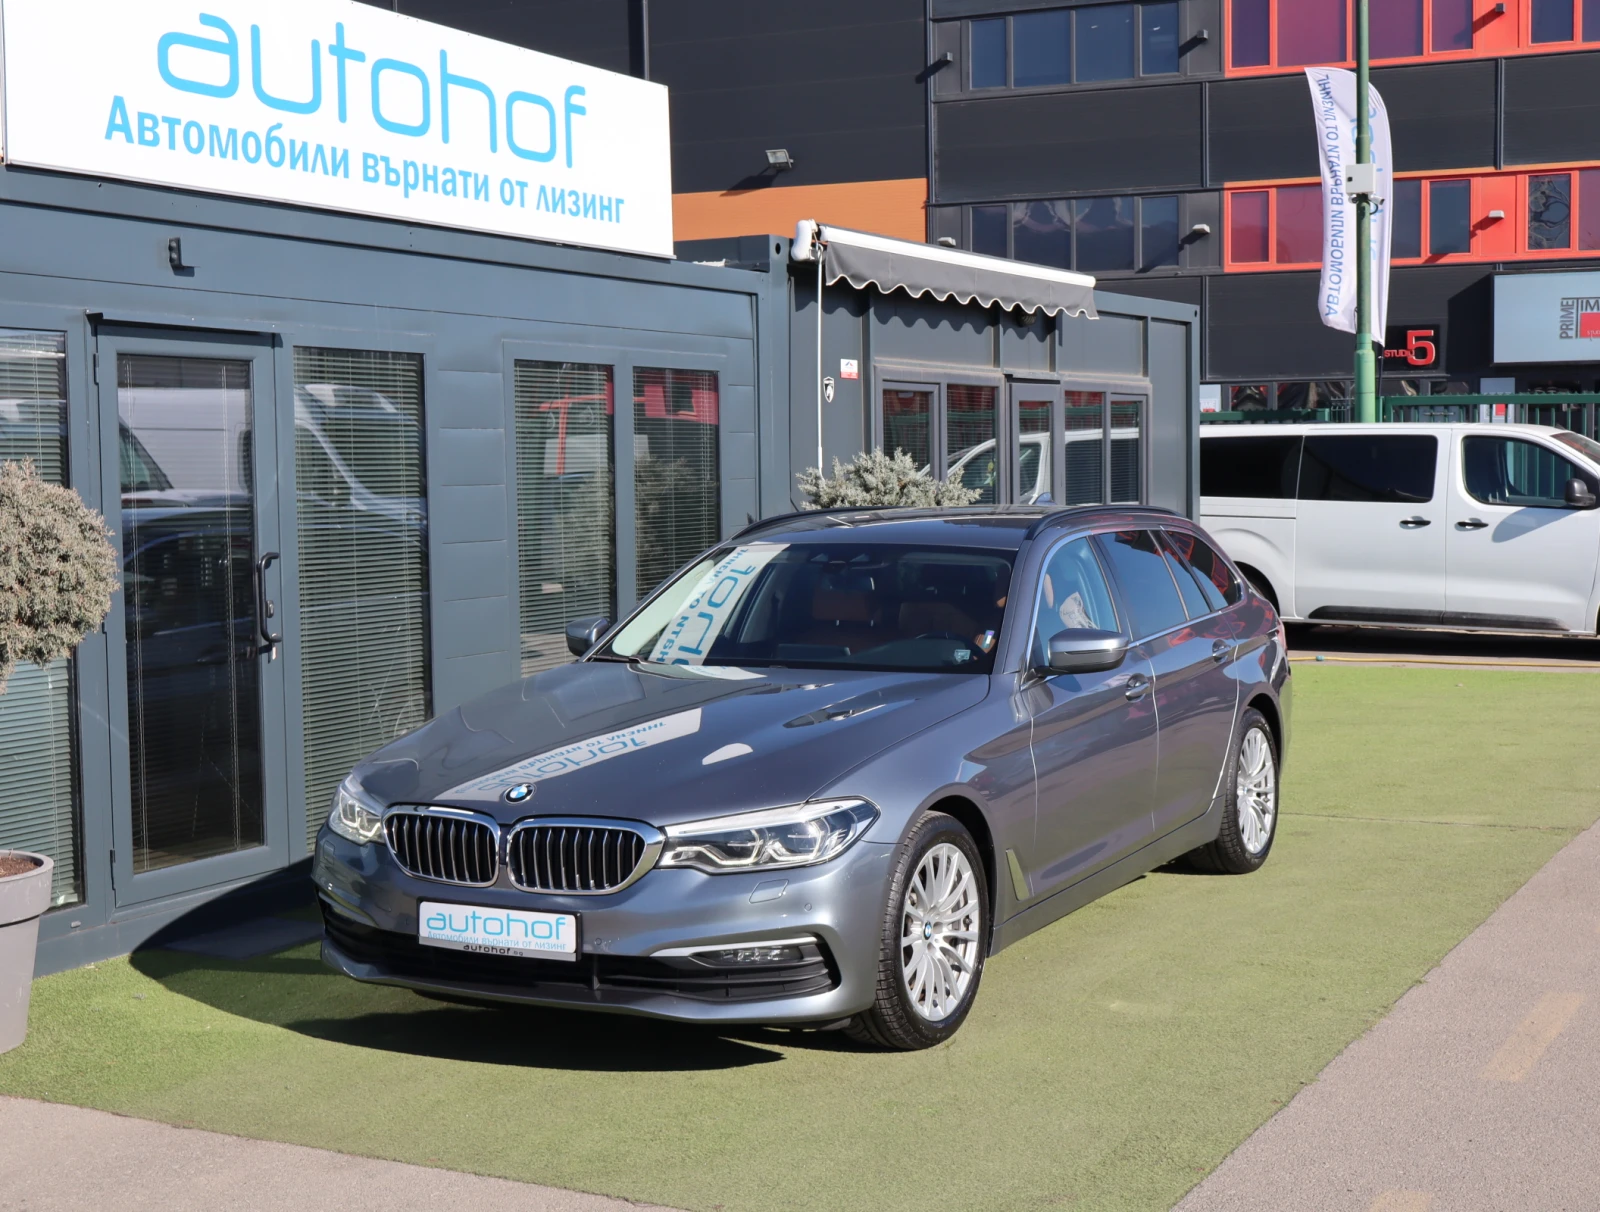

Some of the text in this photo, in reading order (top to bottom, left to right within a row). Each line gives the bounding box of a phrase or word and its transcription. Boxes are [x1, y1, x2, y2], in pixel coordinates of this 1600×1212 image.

[158, 13, 587, 169] autohof
[105, 96, 625, 224] Автомобили върнати от лизинг
[1559, 300, 1575, 339] PRIME
[1407, 329, 1436, 366] 5
[426, 910, 566, 940] autohof
